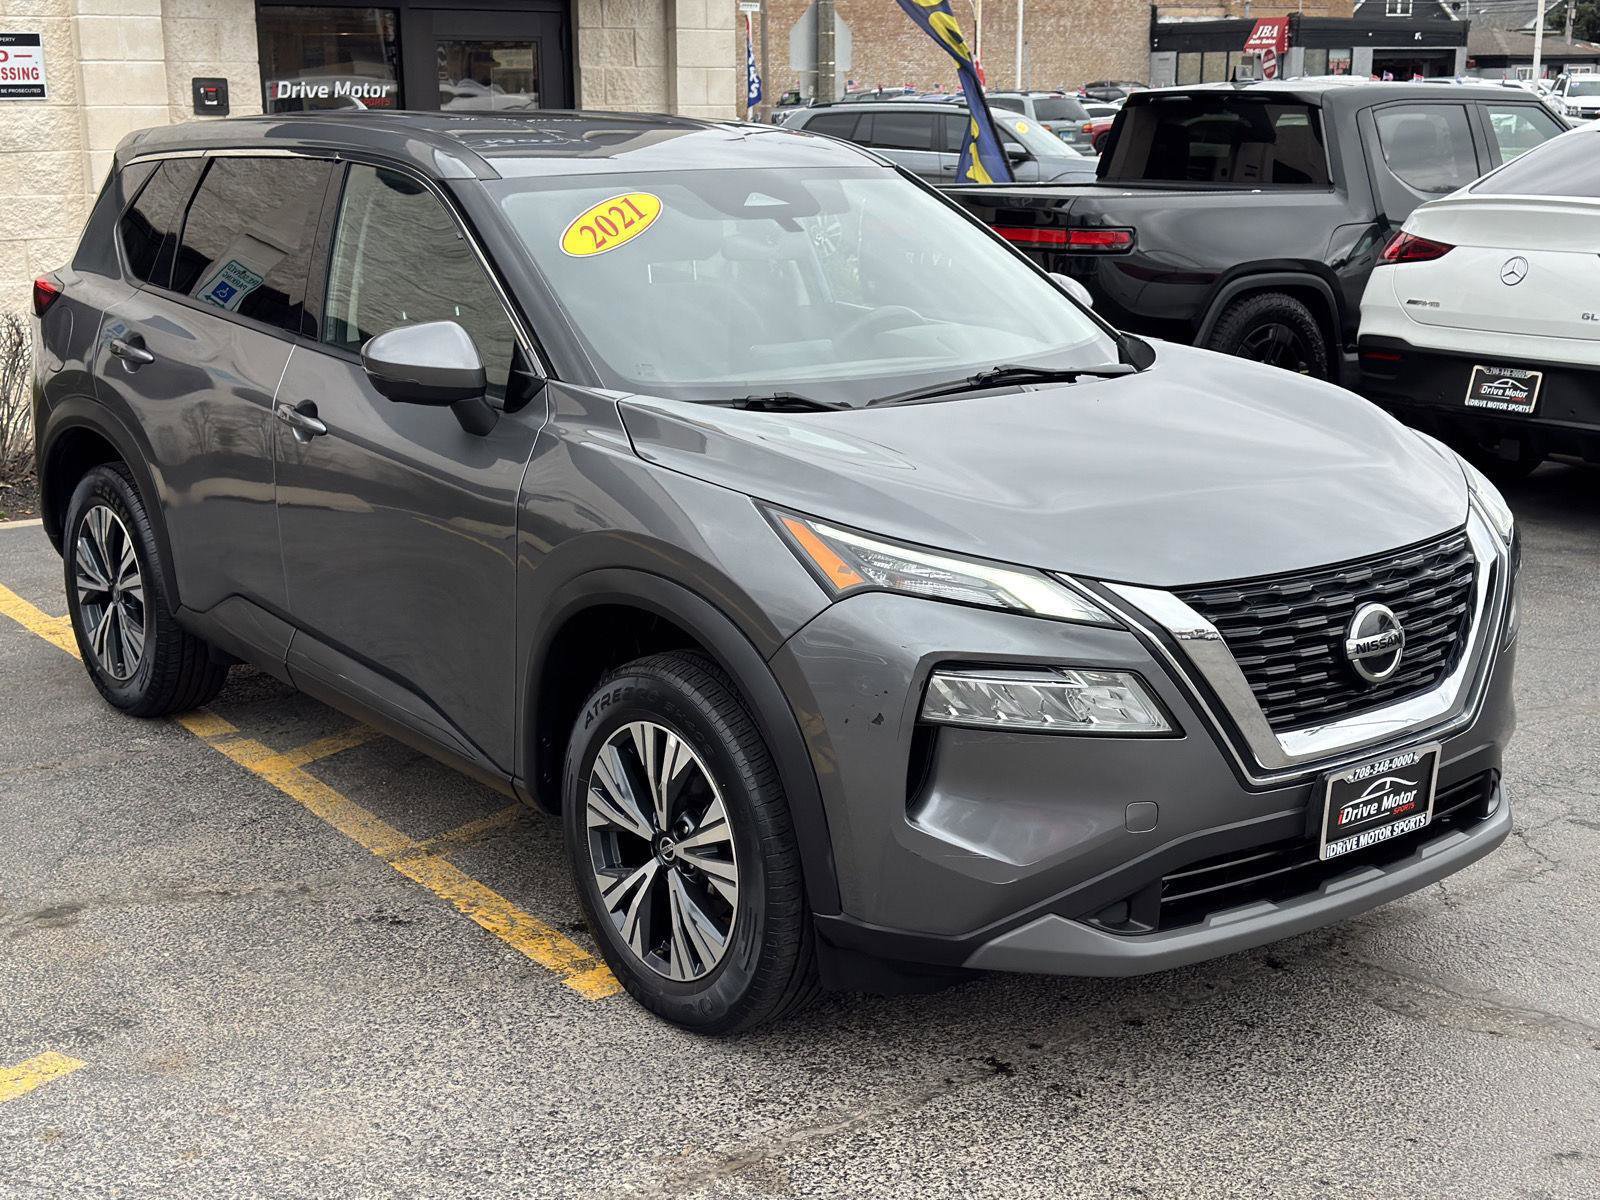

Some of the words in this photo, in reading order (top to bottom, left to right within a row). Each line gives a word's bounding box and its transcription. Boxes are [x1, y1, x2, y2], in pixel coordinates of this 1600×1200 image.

[1252, 25, 1278, 38] JBA
[334, 80, 391, 98] Motor
[362, 98, 391, 107] PORTS
[579, 198, 647, 249] 2021
[1505, 388, 1528, 399] Motor
[1487, 400, 1508, 410] MOTOR
[1508, 403, 1530, 413] SPORTS
[1356, 633, 1400, 654] NISSAN
[1354, 753, 1413, 779] 708-348-0000
[1338, 803, 1378, 825] iDrive
[1381, 789, 1417, 811] Motor
[1392, 801, 1416, 815] SPORTS
[1359, 825, 1392, 847] MOTOR
[1393, 813, 1426, 836] SPORTS
